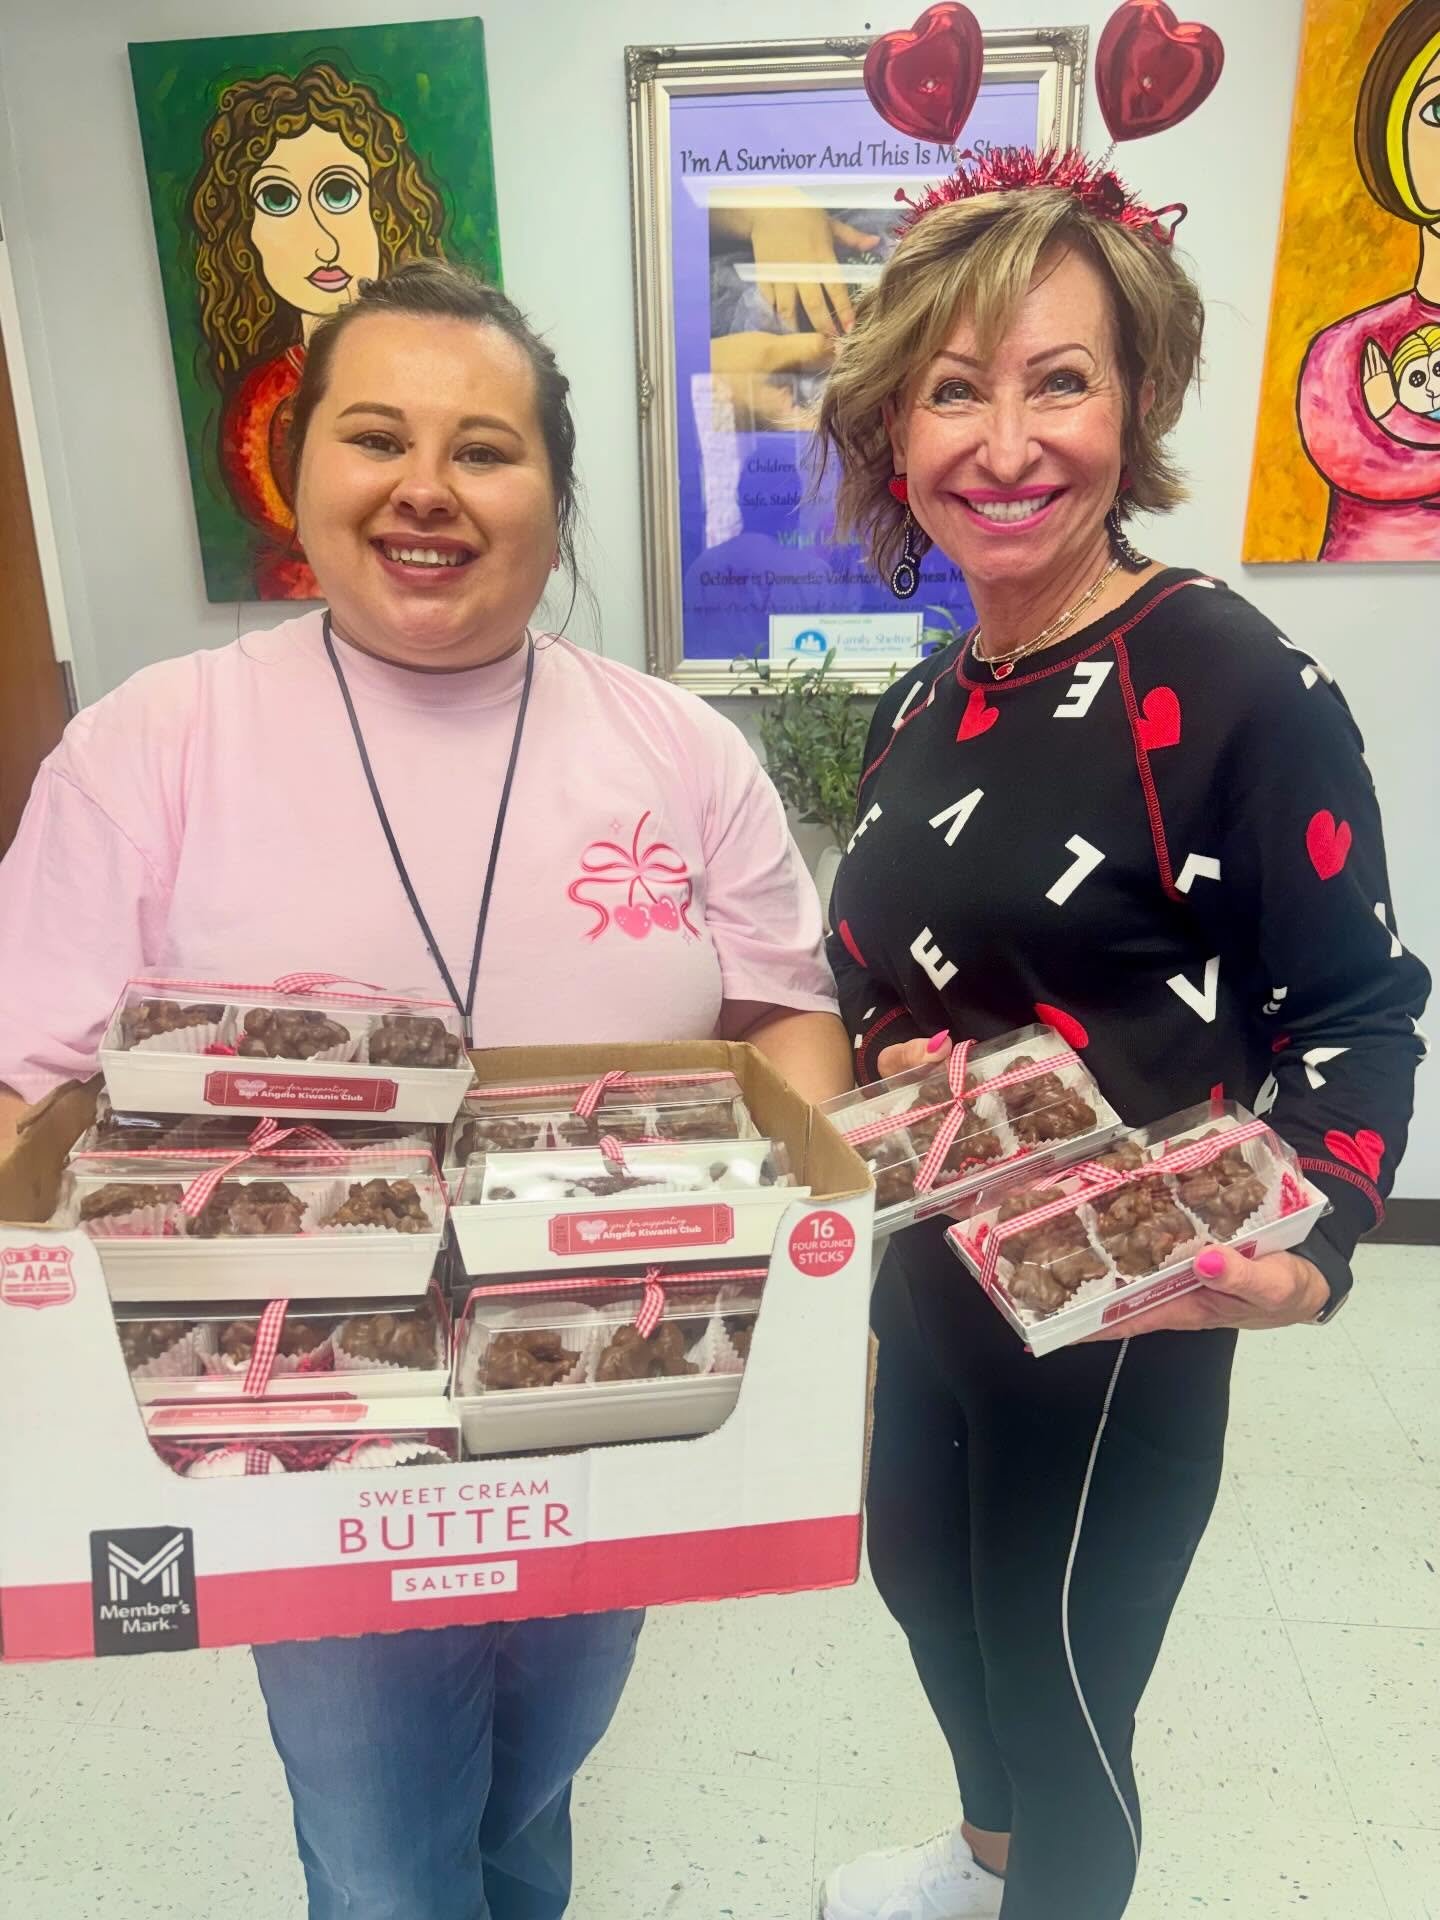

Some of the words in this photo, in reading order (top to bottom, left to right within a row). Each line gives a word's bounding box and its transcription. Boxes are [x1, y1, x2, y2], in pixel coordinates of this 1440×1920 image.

[680, 149, 711, 173] I'm
[715, 149, 732, 172] A
[737, 148, 816, 172] Survivor
[819, 141, 862, 169] And
[867, 139, 910, 167] This
[915, 143, 930, 165] Is
[936, 144, 964, 164] M
[260, 1090, 296, 1101] Angelo
[298, 1091, 339, 1102] Kiwanis
[340, 1092, 364, 1102] Club
[602, 1230, 637, 1241] Angelo
[638, 1227, 678, 1238] Kiwanis
[679, 1224, 702, 1234] Club
[810, 1217, 835, 1240] 16
[793, 1240, 819, 1251] FOUR
[819, 1238, 854, 1249] OUNCE
[798, 1250, 845, 1265] STICKS
[23, 1264, 50, 1282] AA
[359, 1486, 447, 1509] SWEET
[458, 1479, 550, 1502] CREAM
[339, 1502, 574, 1555] BUTTER
[404, 1569, 506, 1593] SALTED
[100, 1600, 191, 1621] Member's
